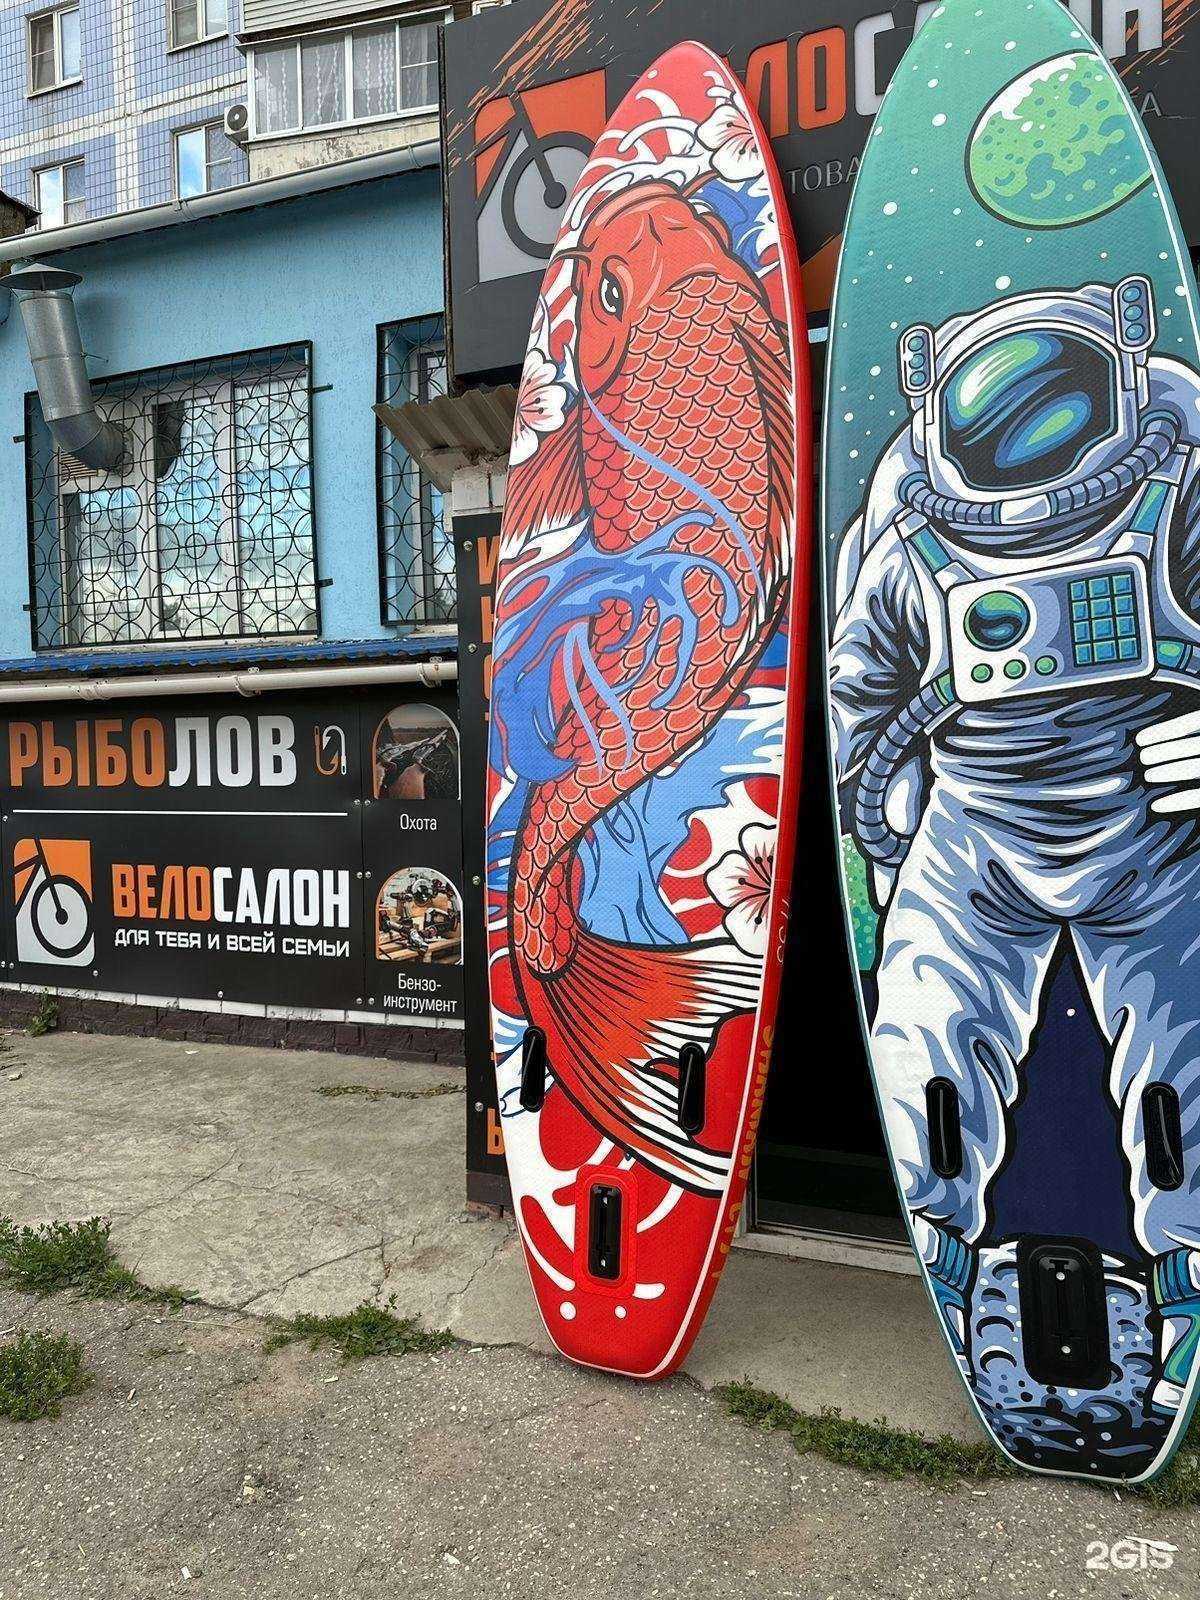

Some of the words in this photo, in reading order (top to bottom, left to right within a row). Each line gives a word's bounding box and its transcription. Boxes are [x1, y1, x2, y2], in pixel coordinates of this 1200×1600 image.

[8, 715, 298, 788] РЫБОЛОВ
[399, 813, 438, 832] Охота
[111, 863, 350, 929] ВЕЛОСАЛОН
[114, 928, 150, 948] ДЛЯ
[155, 930, 201, 951] ТЕБЯ
[206, 934, 221, 951] И
[226, 932, 276, 954] ВСЕЙ
[282, 937, 350, 958] СЕМЬИ
[397, 973, 442, 993] Бензо-
[382, 994, 458, 1014] инструмент
